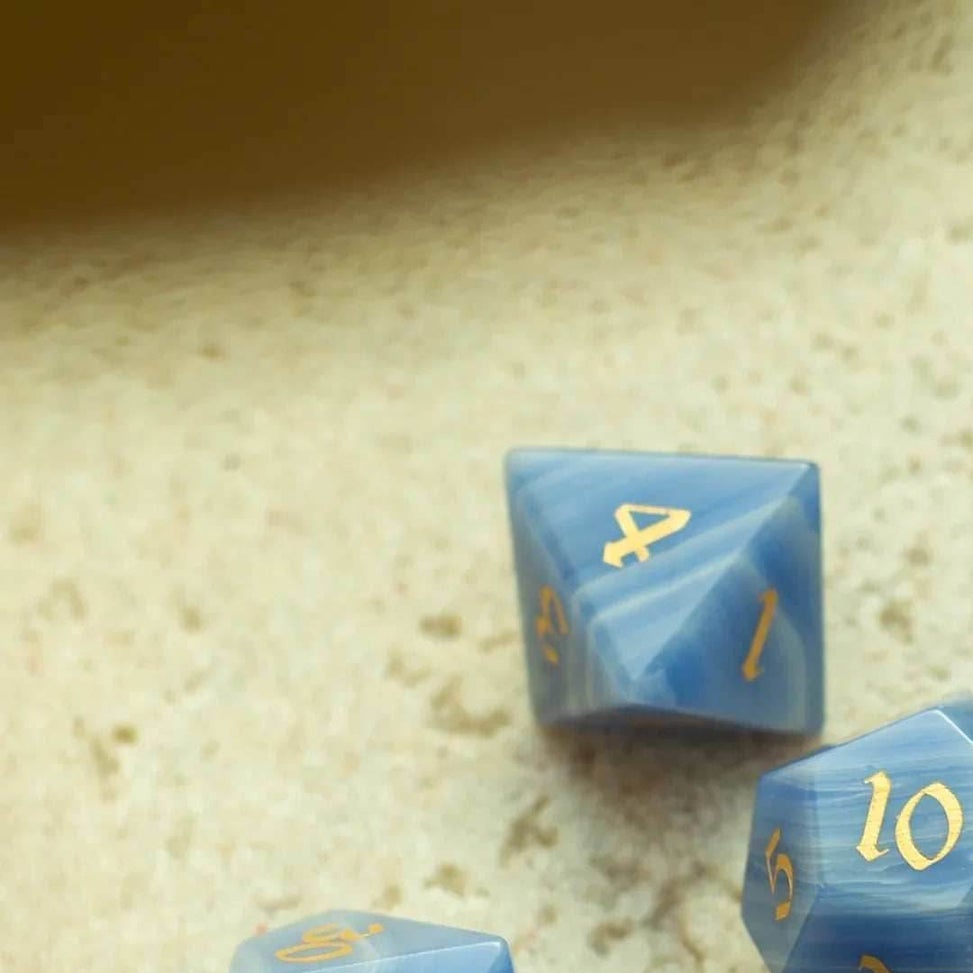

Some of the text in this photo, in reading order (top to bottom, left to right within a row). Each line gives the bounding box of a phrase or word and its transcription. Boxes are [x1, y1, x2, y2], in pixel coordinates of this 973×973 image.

[603, 503, 692, 568] 4
[741, 588, 779, 682] 1
[855, 770, 964, 871] 10
[764, 827, 794, 921] 5
